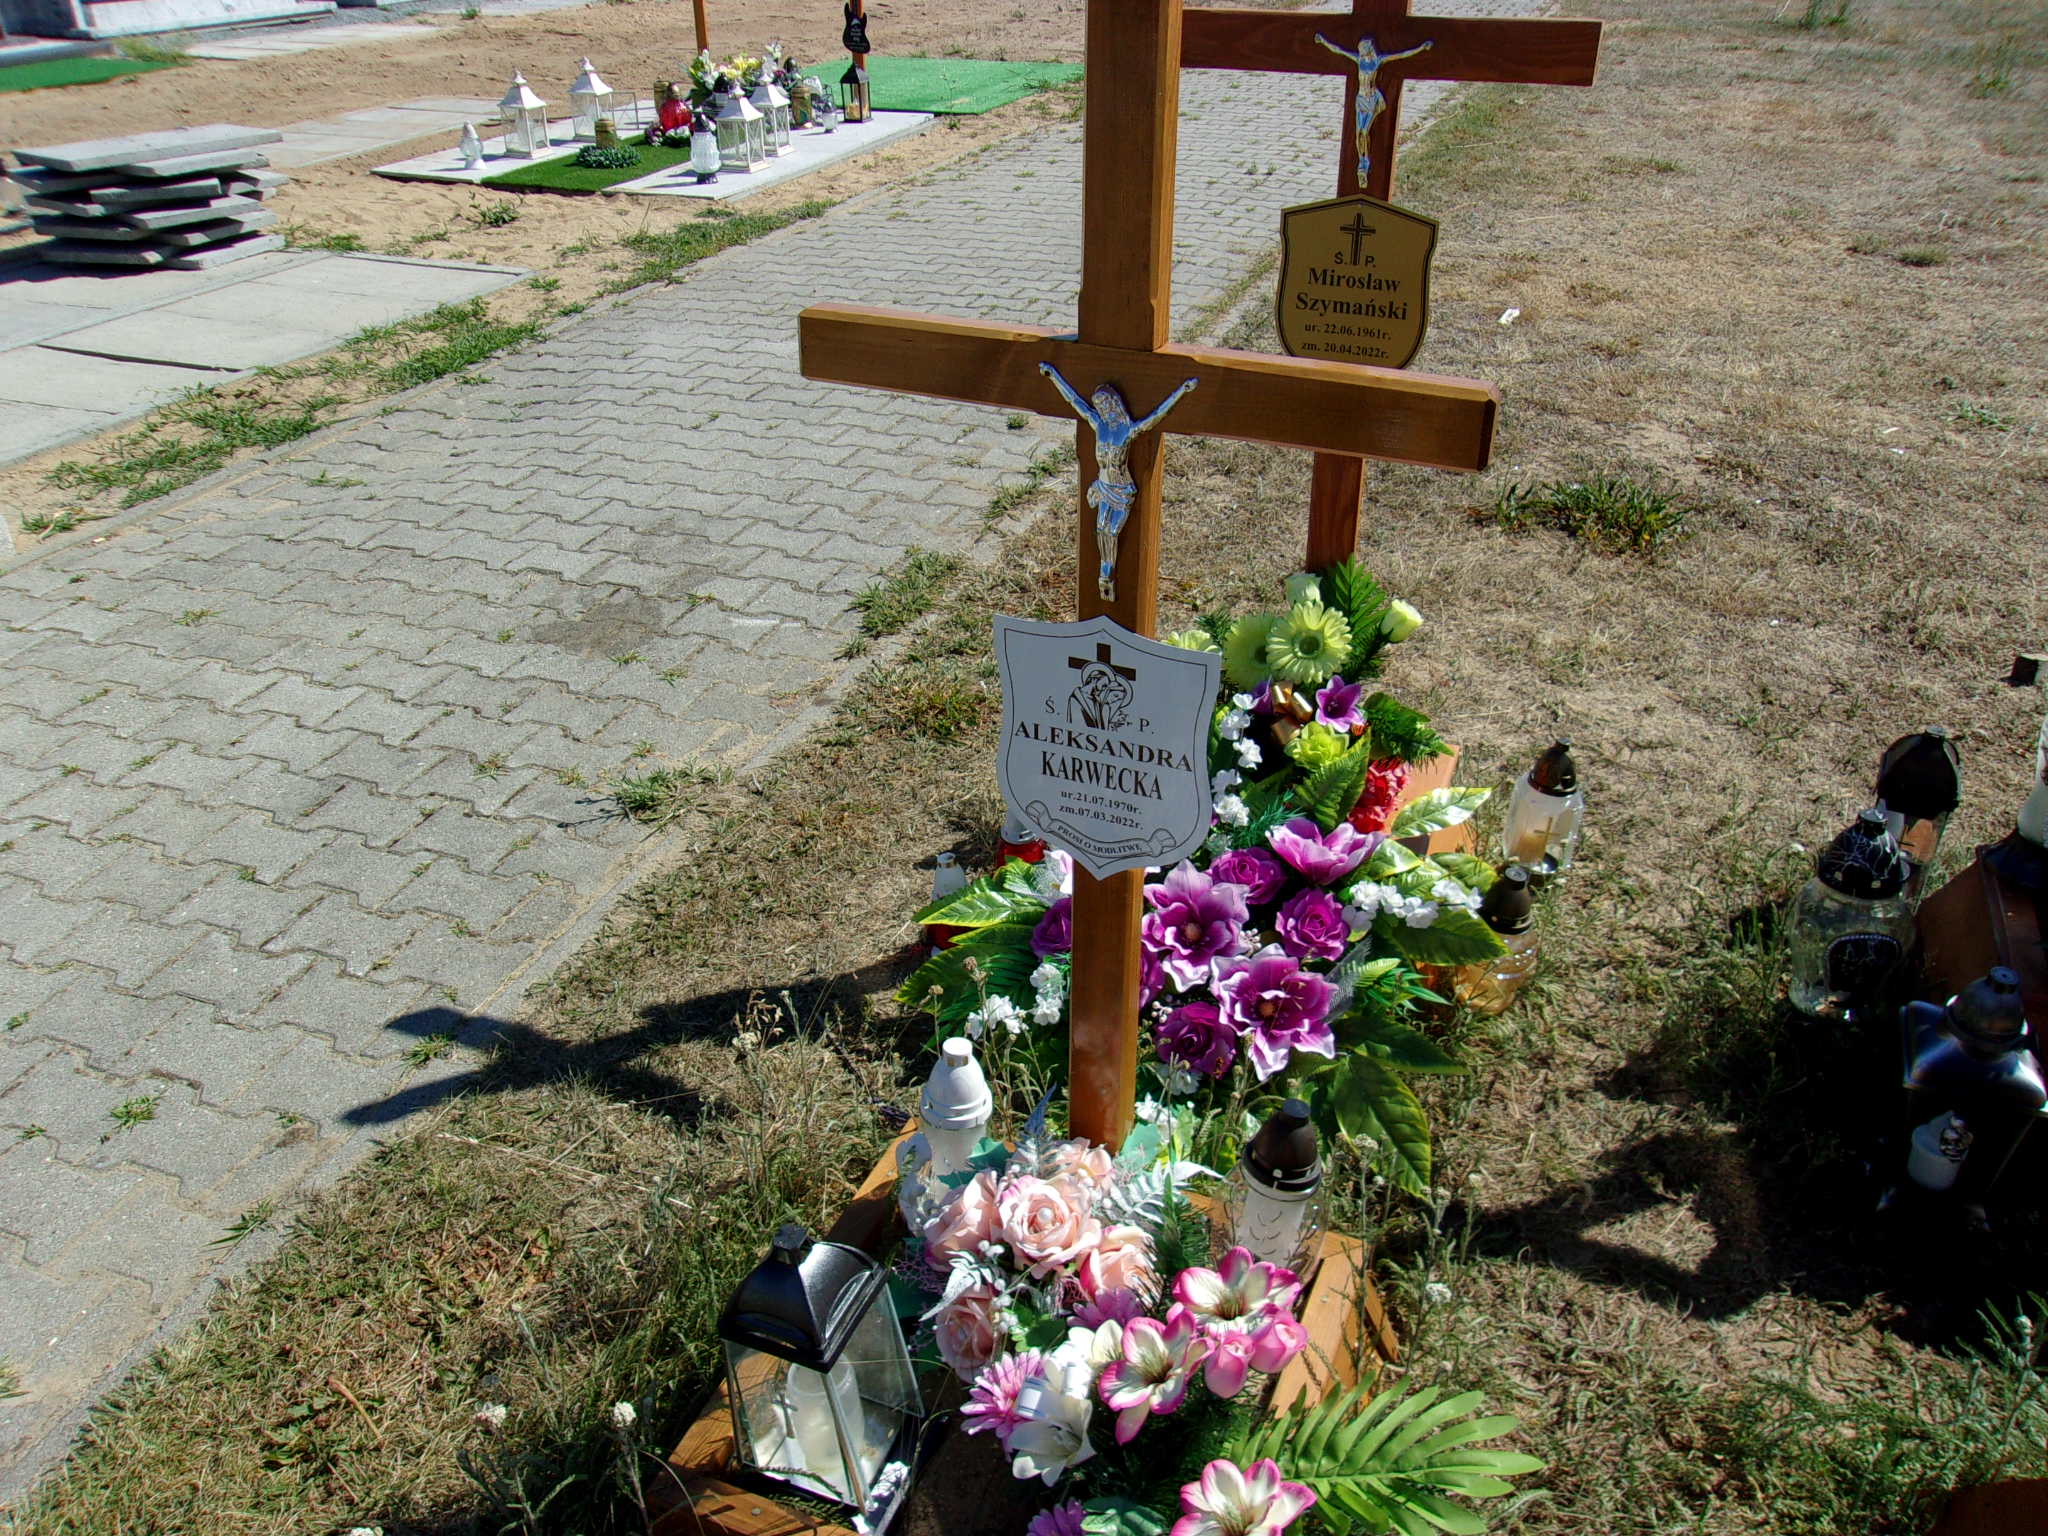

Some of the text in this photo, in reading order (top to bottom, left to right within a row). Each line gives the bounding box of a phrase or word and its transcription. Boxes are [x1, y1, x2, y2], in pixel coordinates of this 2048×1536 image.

[1365, 255, 1376, 268] P.
[1308, 267, 1401, 292] Mirosław
[1296, 292, 1408, 320] Szymański
[1304, 323, 1391, 340] ur. 22.06.1961r.
[1302, 342, 1389, 359] zm. 20.04.2022r.
[1045, 696, 1155, 734] Ś. P.
[1014, 720, 1192, 772] ALEKSANDRA
[1041, 751, 1163, 800] KARWECKA
[1061, 790, 1142, 815] ur.21.07.1970r.
[1059, 805, 1143, 830] zm.07.03.2022r.
